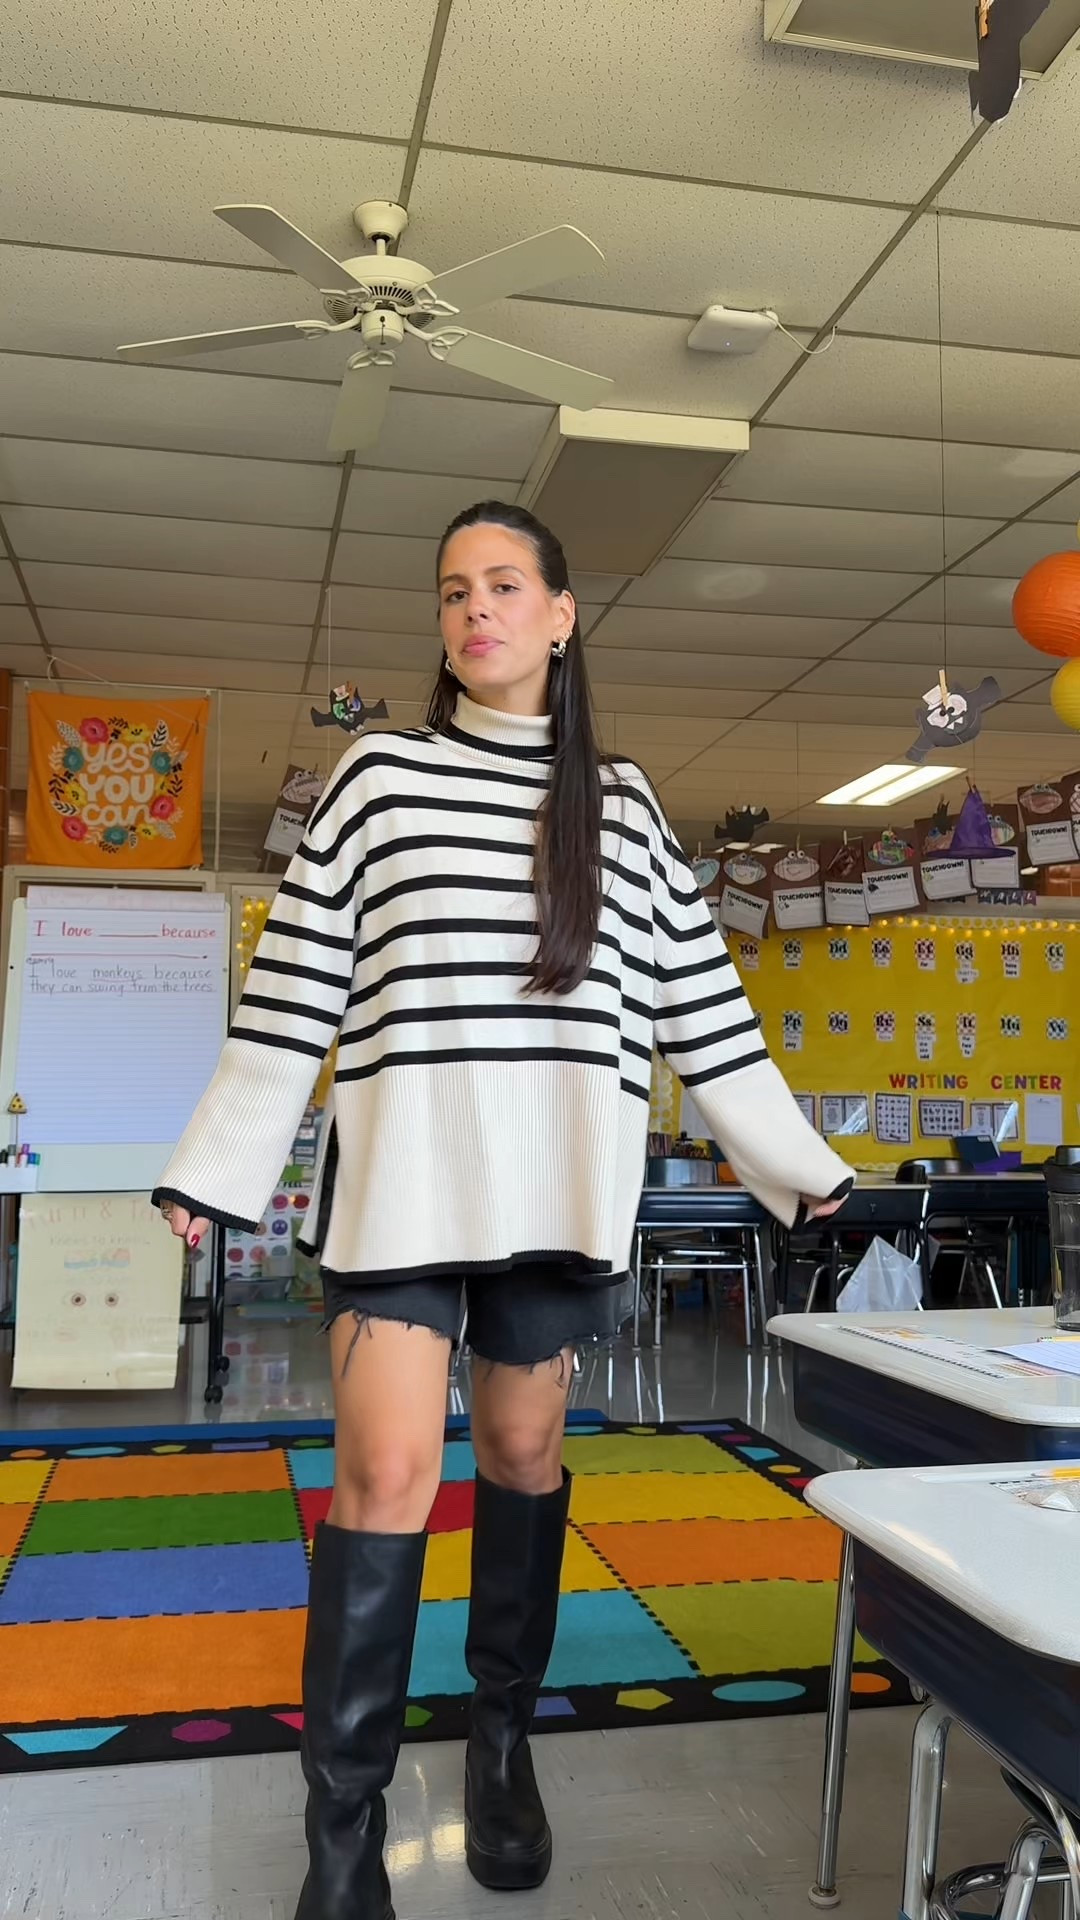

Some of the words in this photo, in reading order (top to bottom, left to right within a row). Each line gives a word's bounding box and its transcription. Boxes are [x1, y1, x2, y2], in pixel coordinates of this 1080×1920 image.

[922, 861, 964, 873] TOUCHDOWN!
[867, 872, 909, 883] TOUCHDOWN!
[33, 920, 47, 936] I
[62, 921, 93, 937] love
[162, 924, 216, 939] because
[51, 963, 77, 978] love
[93, 965, 143, 982] monkeys
[154, 963, 212, 979] because
[31, 979, 55, 996] they
[62, 983, 82, 992] can
[88, 983, 124, 997] swing
[163, 980, 180, 992] the
[889, 1074, 969, 1090] WRITING
[990, 1074, 1062, 1091] CENTER
